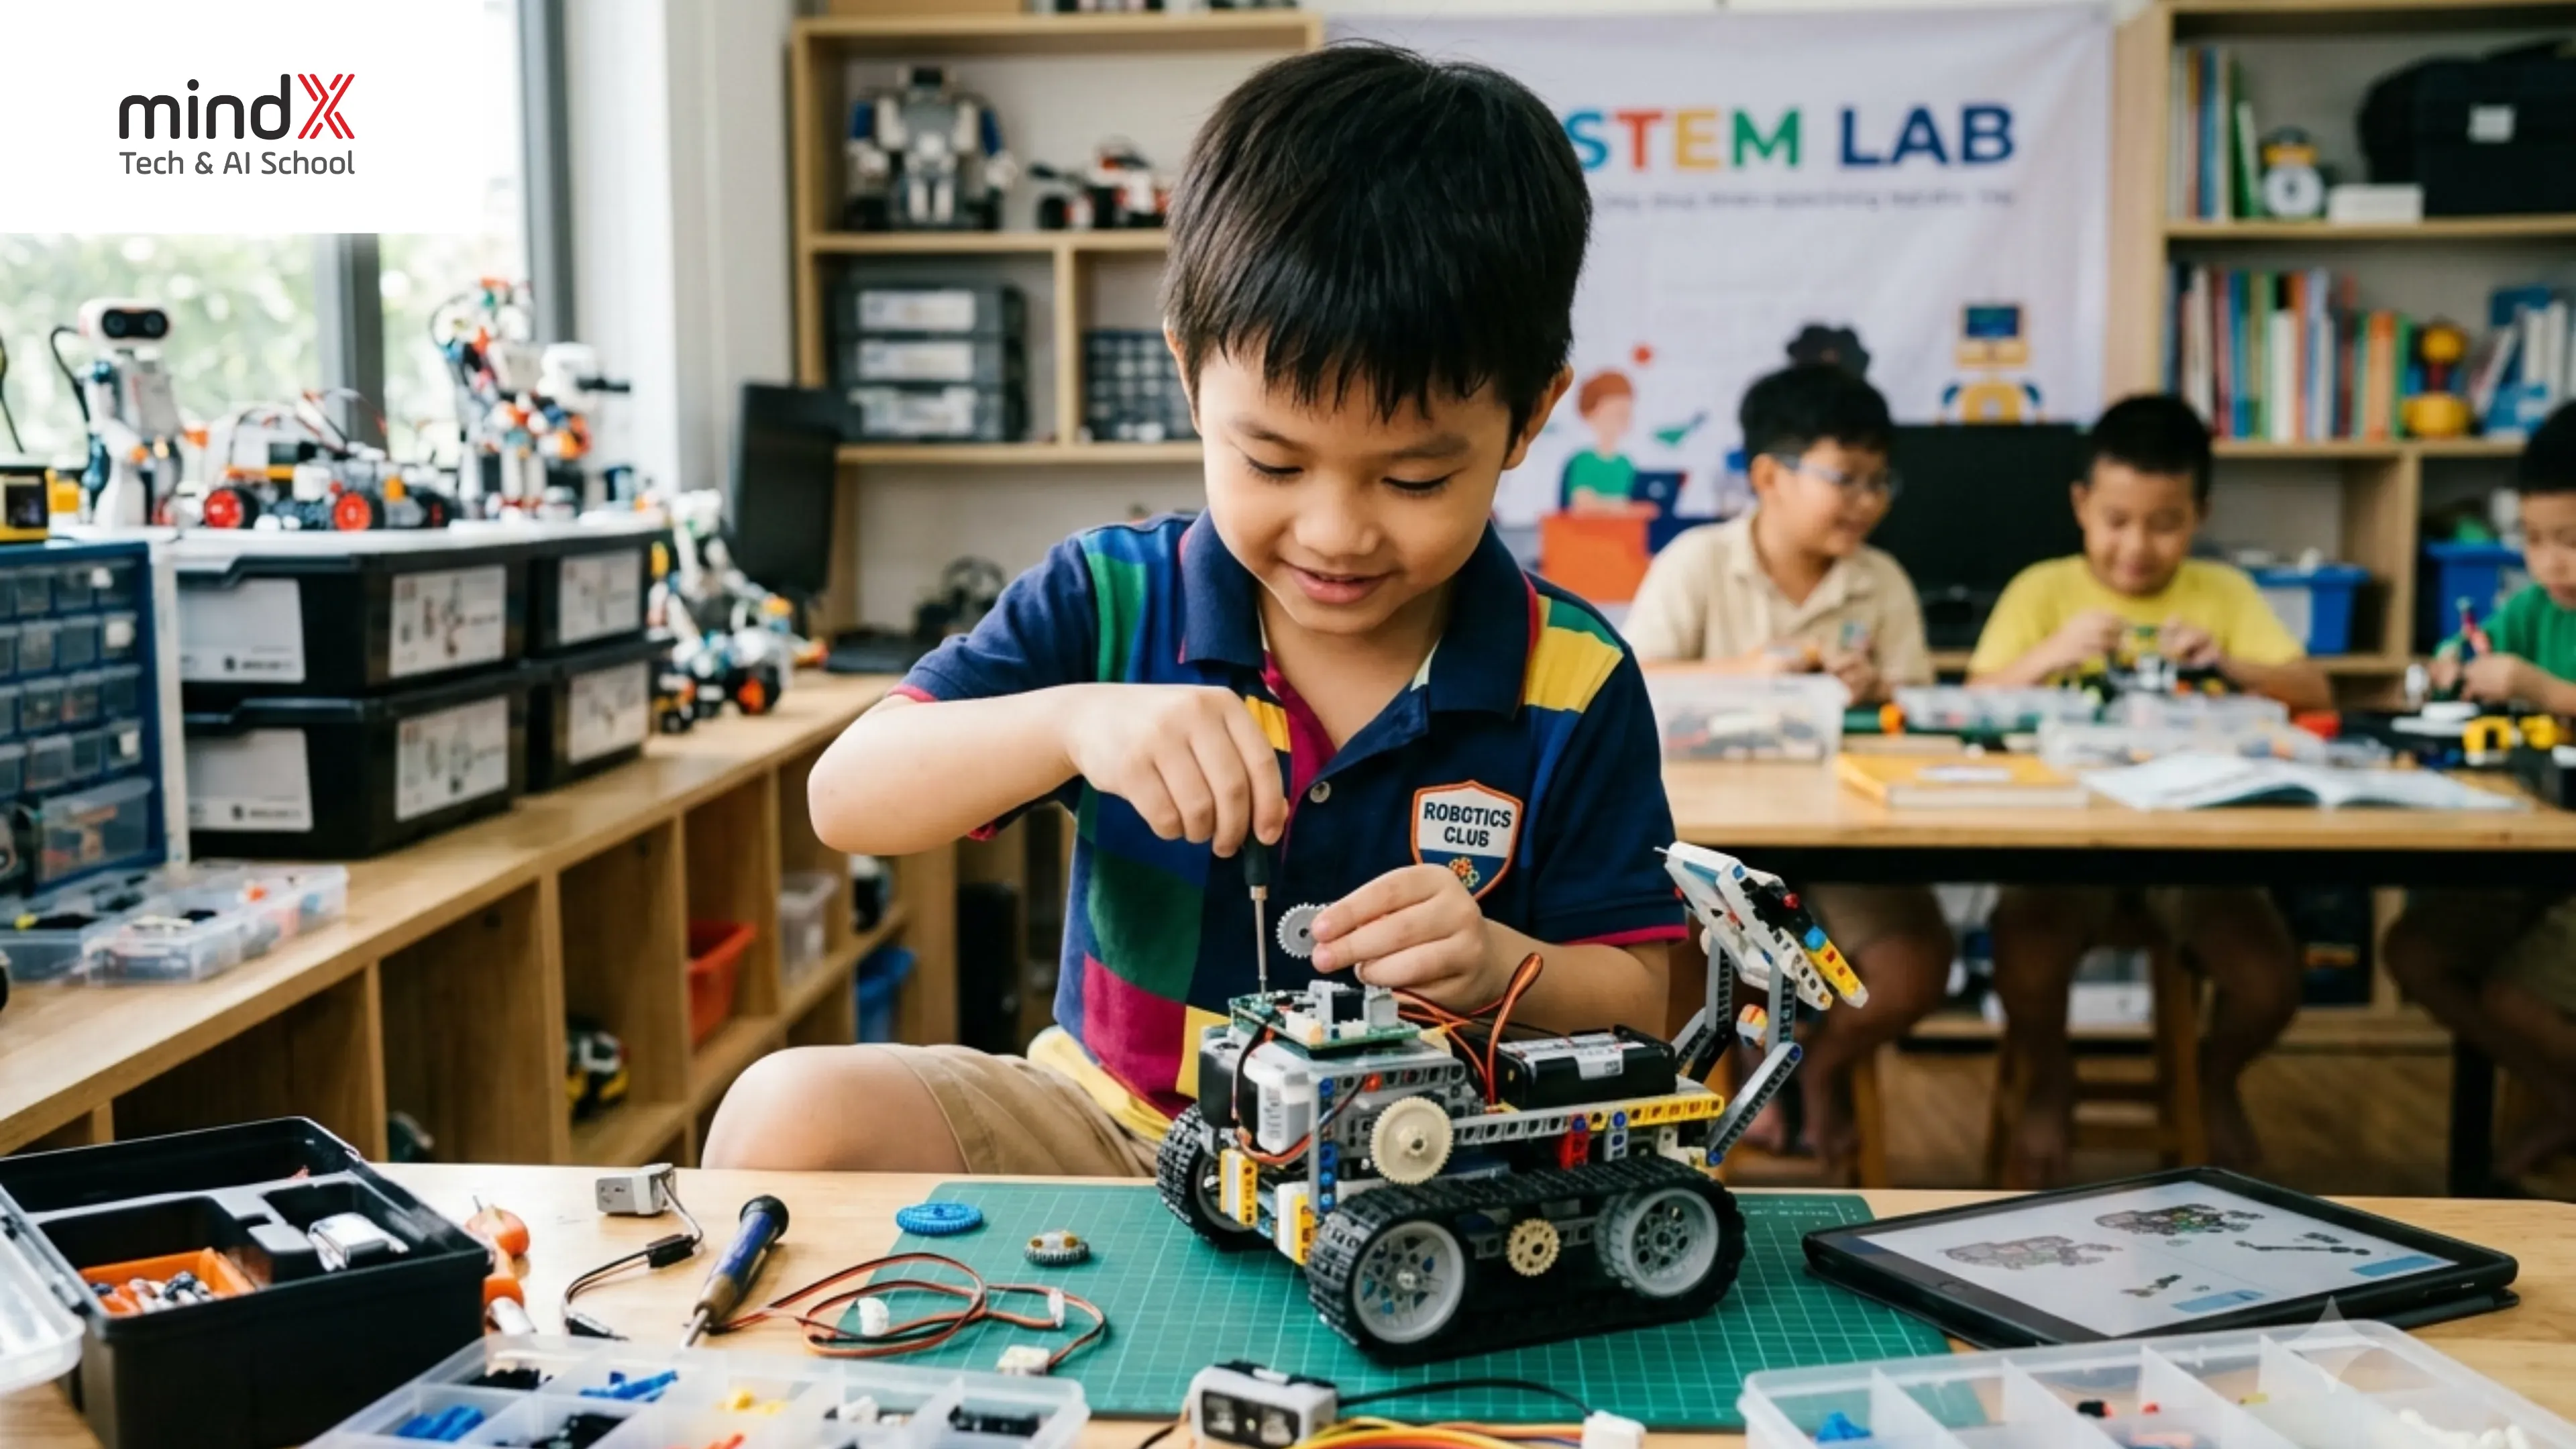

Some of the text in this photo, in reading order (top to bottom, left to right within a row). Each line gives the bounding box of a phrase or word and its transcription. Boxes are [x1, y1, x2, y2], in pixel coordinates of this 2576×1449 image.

[1563, 107, 2015, 169] STEM LAB
[1444, 826, 1490, 847] CLUB
